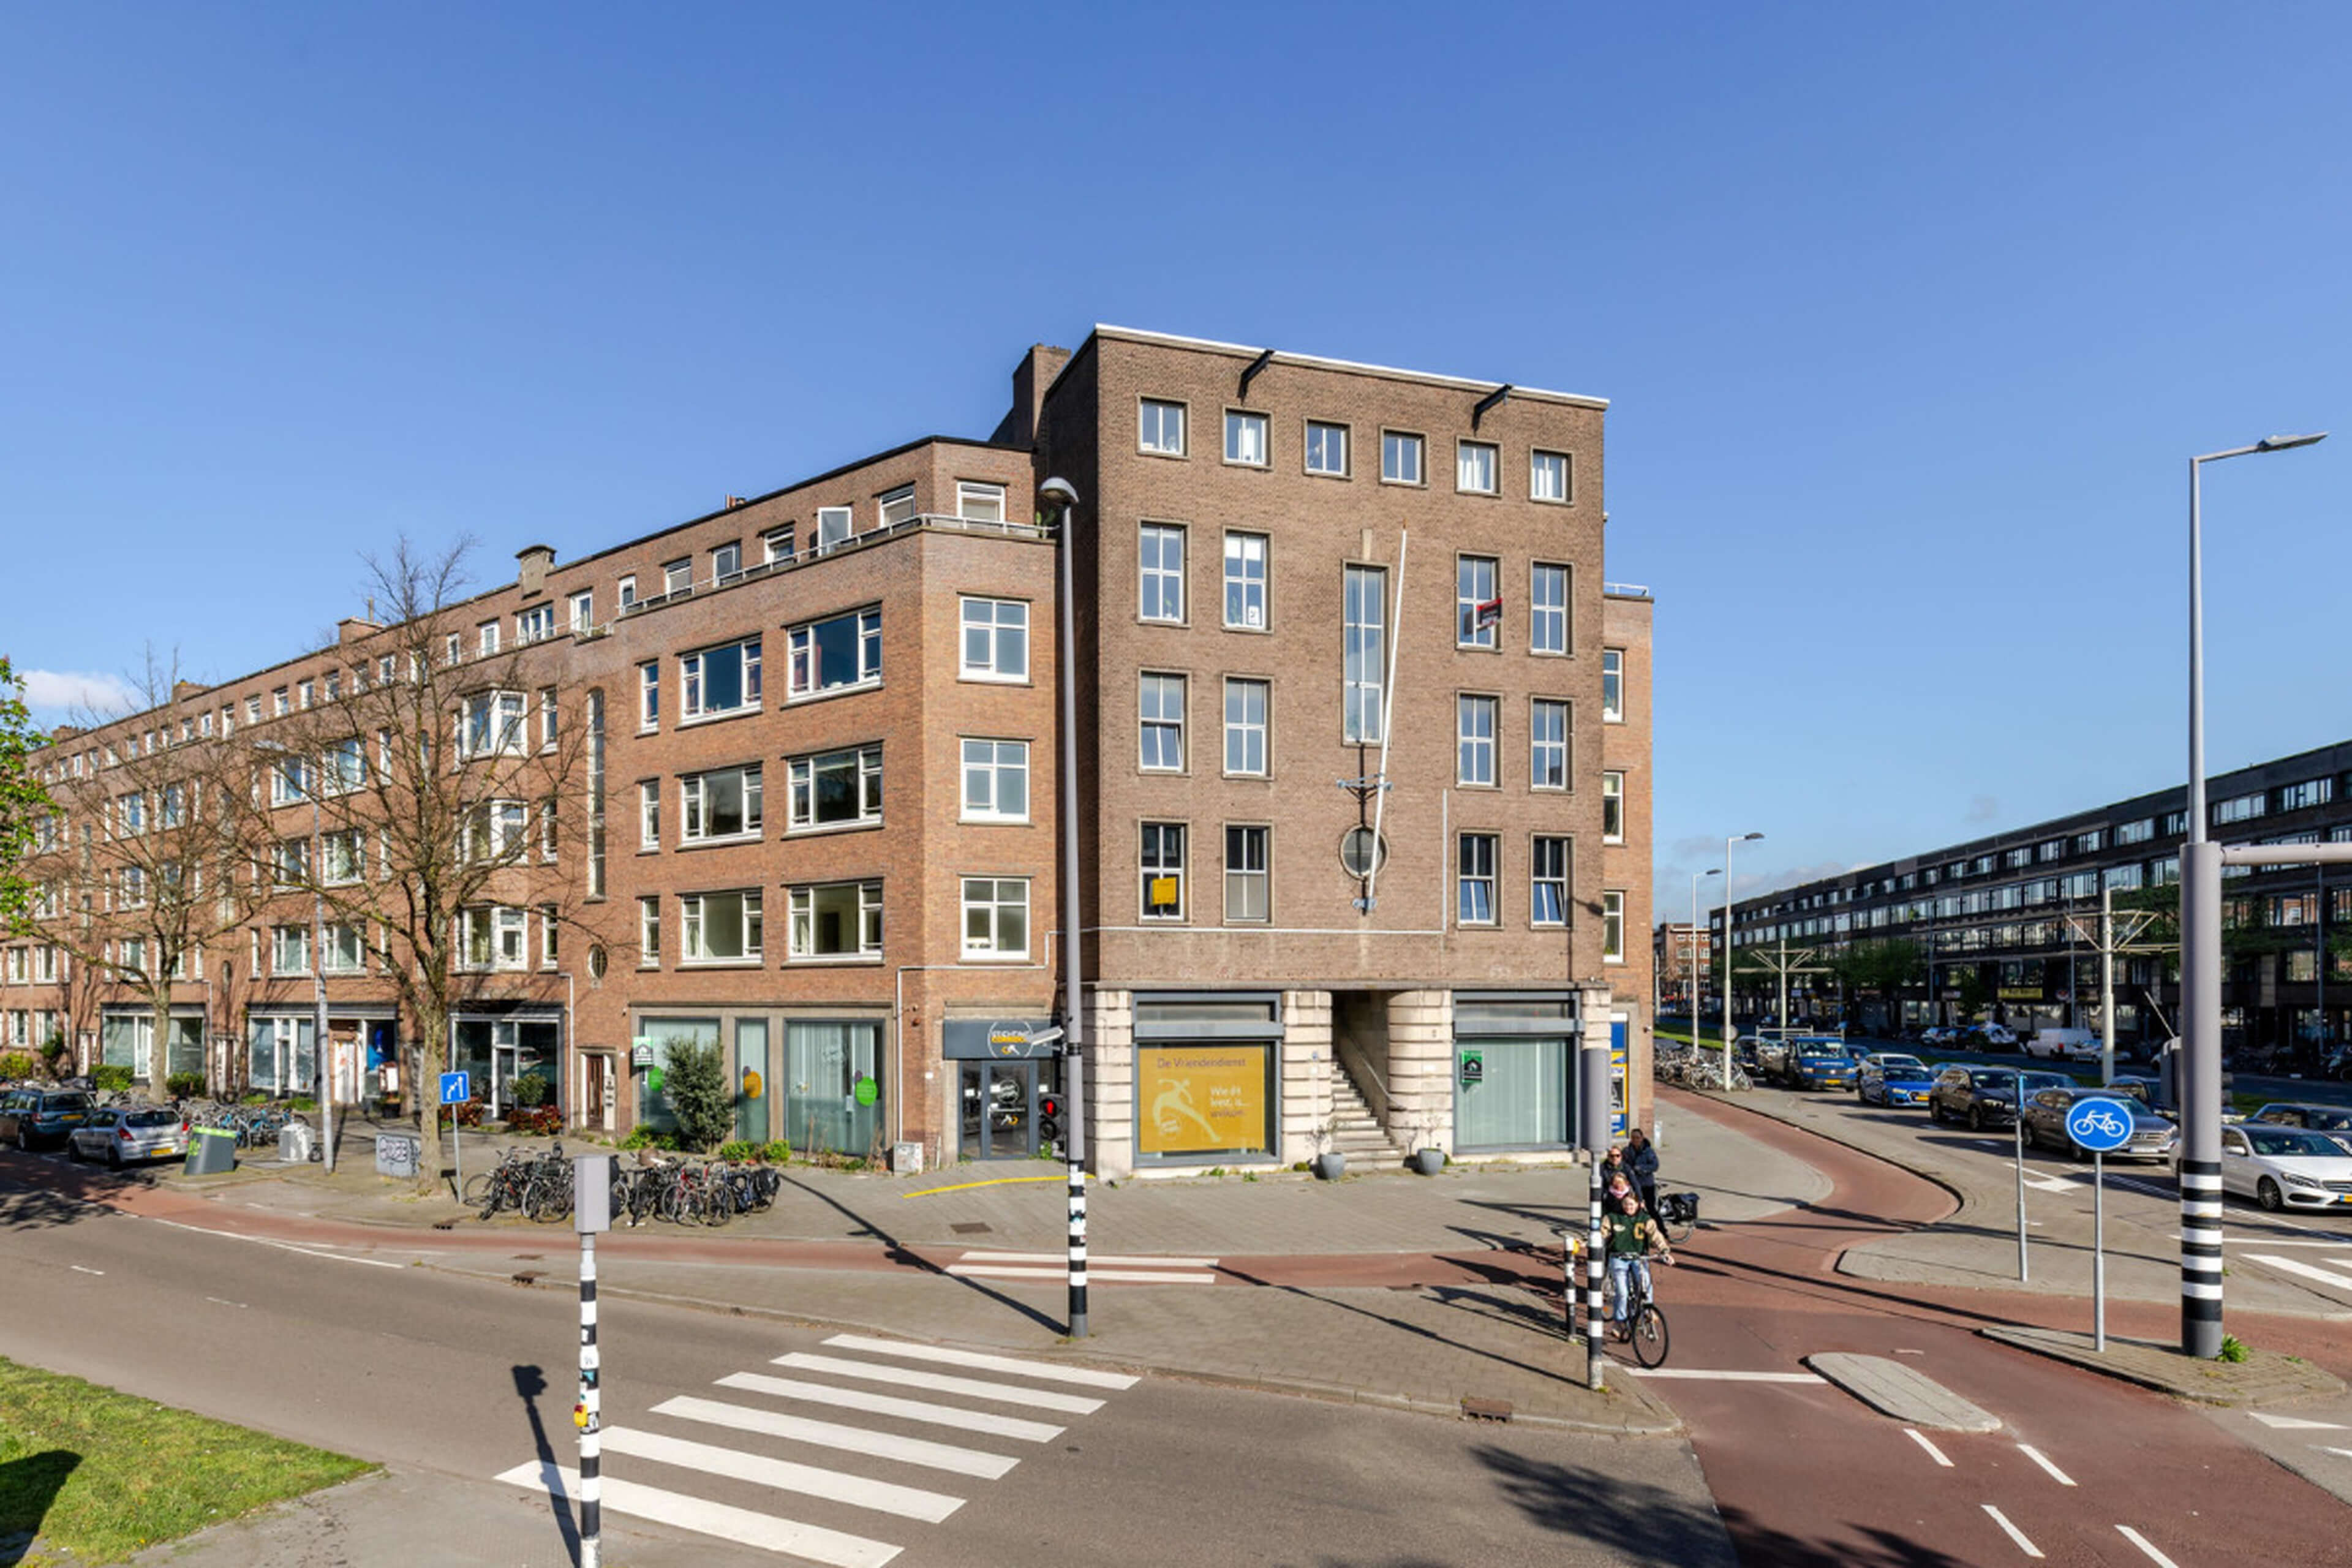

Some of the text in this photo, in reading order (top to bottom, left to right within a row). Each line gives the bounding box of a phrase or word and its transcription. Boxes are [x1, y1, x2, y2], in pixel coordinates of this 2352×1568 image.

[1157, 1057, 1246, 1068] De Vriendendienst
[1210, 1087, 1229, 1096] Wie
[1634, 1223, 1645, 1240] C
